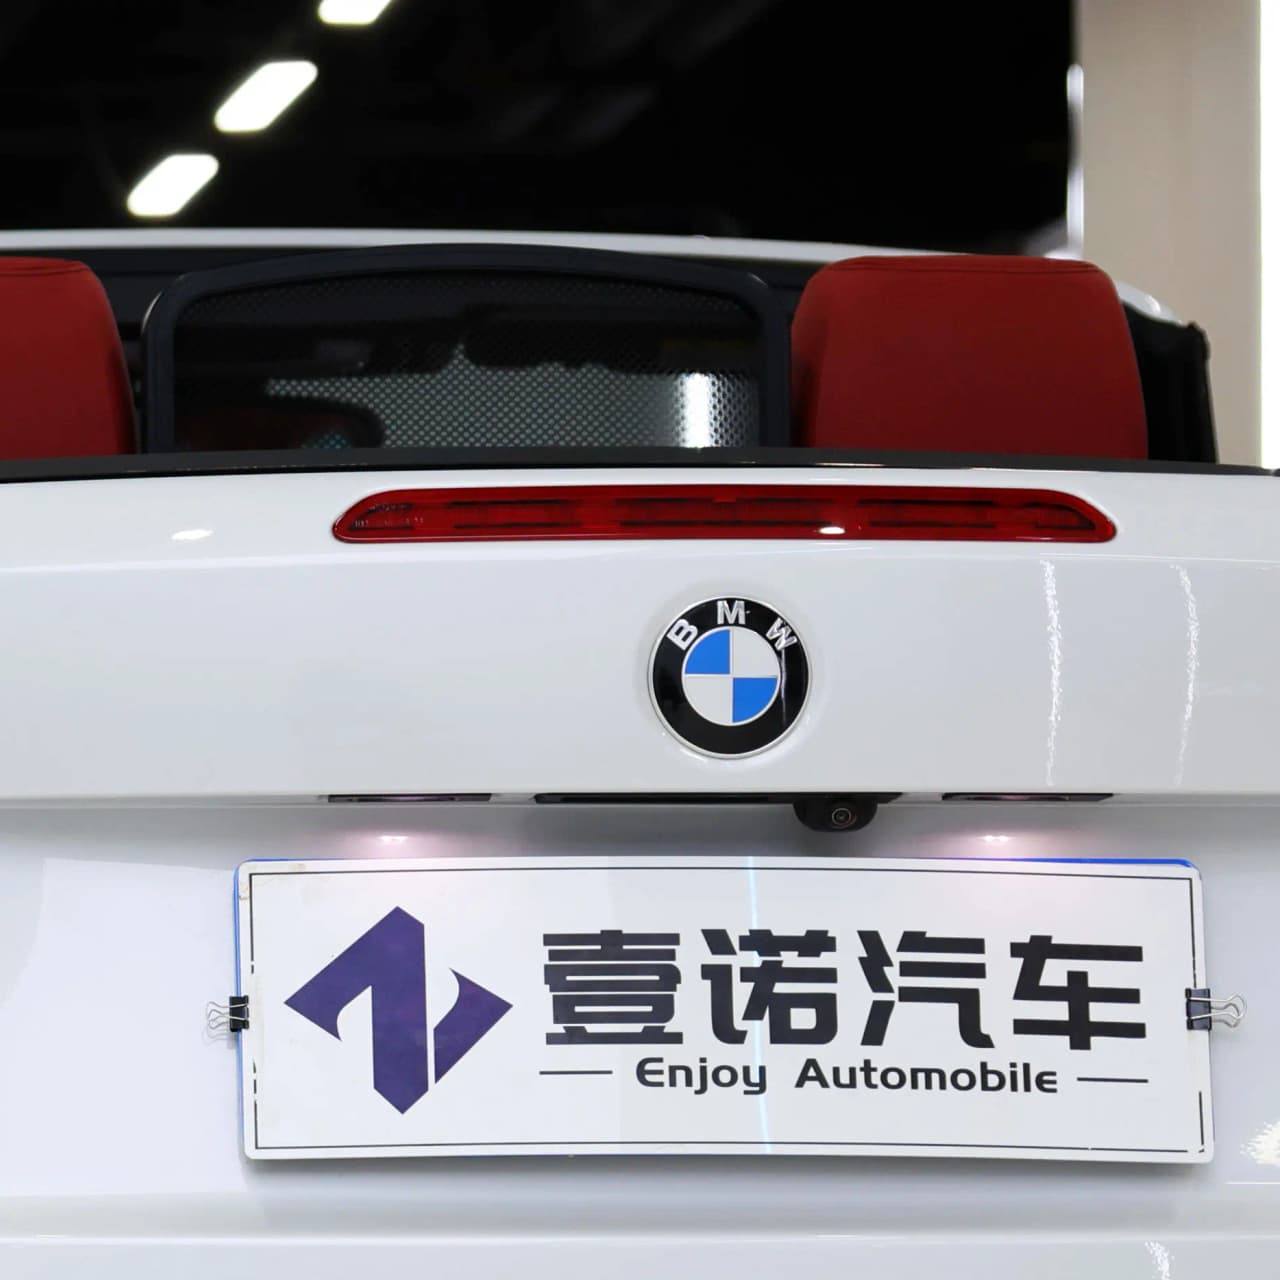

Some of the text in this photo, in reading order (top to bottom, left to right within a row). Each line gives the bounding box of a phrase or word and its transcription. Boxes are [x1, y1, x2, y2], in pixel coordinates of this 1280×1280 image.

[666, 600, 798, 651] BMW
[543, 929, 1146, 1050] 壹诺汽车
[636, 1057, 1059, 1096] Enjoy Automobile
